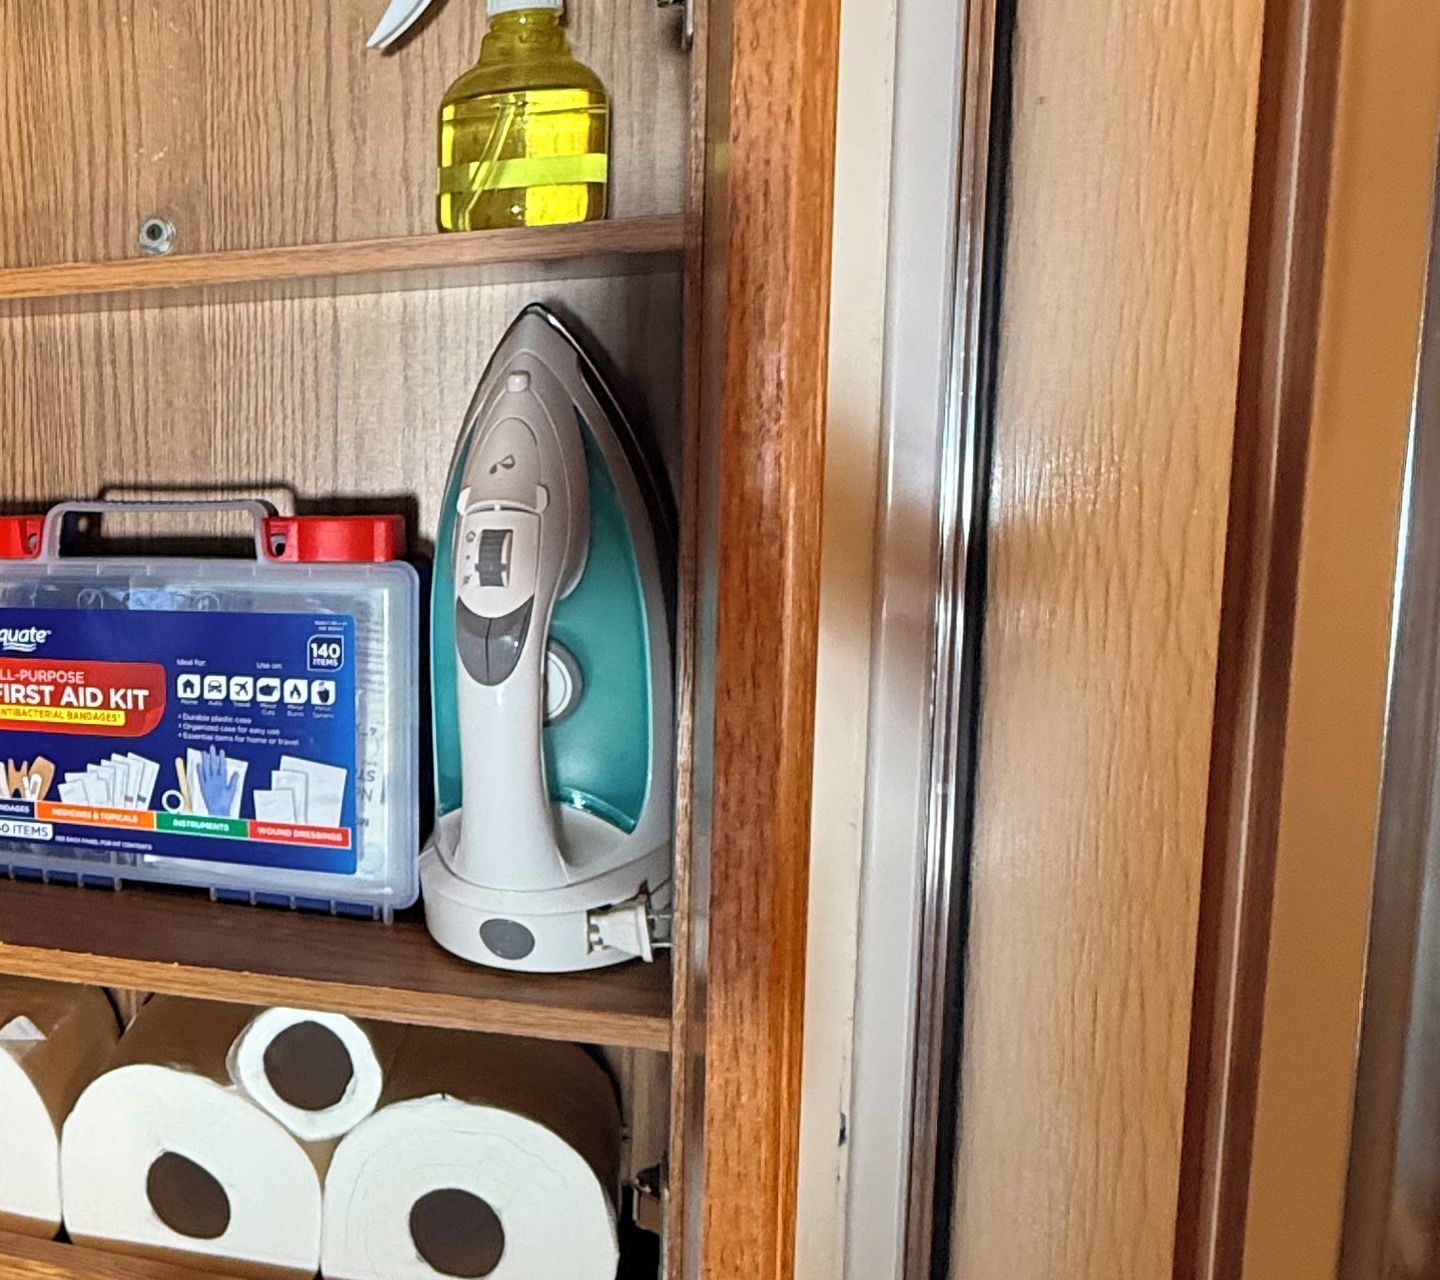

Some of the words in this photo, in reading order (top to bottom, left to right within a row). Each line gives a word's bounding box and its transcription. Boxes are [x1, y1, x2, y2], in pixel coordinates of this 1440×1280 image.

[311, 643, 340, 658] 140
[313, 658, 338, 667] ITEMS
[60, 686, 104, 707] AID
[109, 688, 149, 710] KIT
[211, 715, 234, 724] plastic
[182, 723, 220, 733] Organized
[249, 727, 265, 735] easy
[214, 734, 233, 742] items
[235, 735, 245, 743] for
[246, 735, 267, 744] home
[278, 738, 299, 746] travel
[13, 826, 49, 837] ITEMS
[172, 819, 230, 832] INSTRUMENTS
[257, 827, 292, 837] WOUND
[293, 830, 342, 842] DRESSINGS
